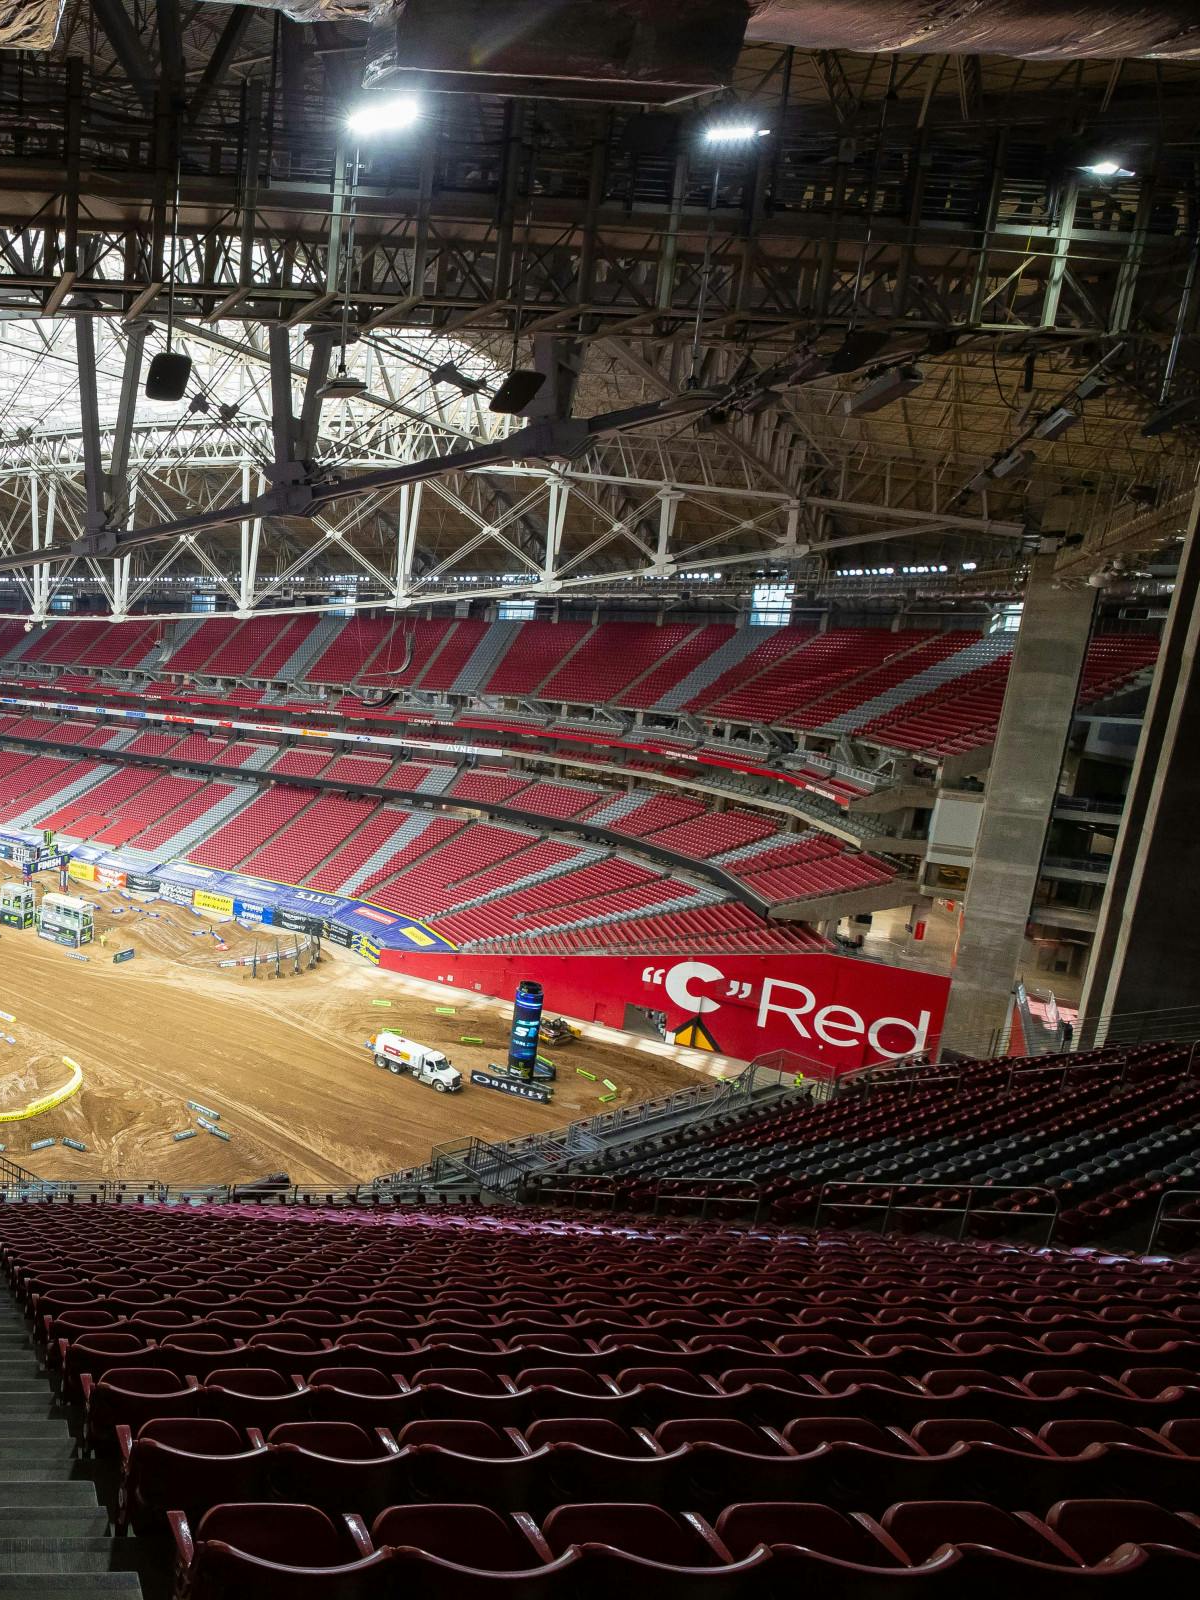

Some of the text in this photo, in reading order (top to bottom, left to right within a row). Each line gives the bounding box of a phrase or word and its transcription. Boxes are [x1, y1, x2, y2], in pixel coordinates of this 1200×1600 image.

[446, 744, 479, 753] AVNET
[38, 858, 61, 871] FINISH
[756, 976, 931, 1060] Red
[491, 1079, 544, 1100] OAKLEY
